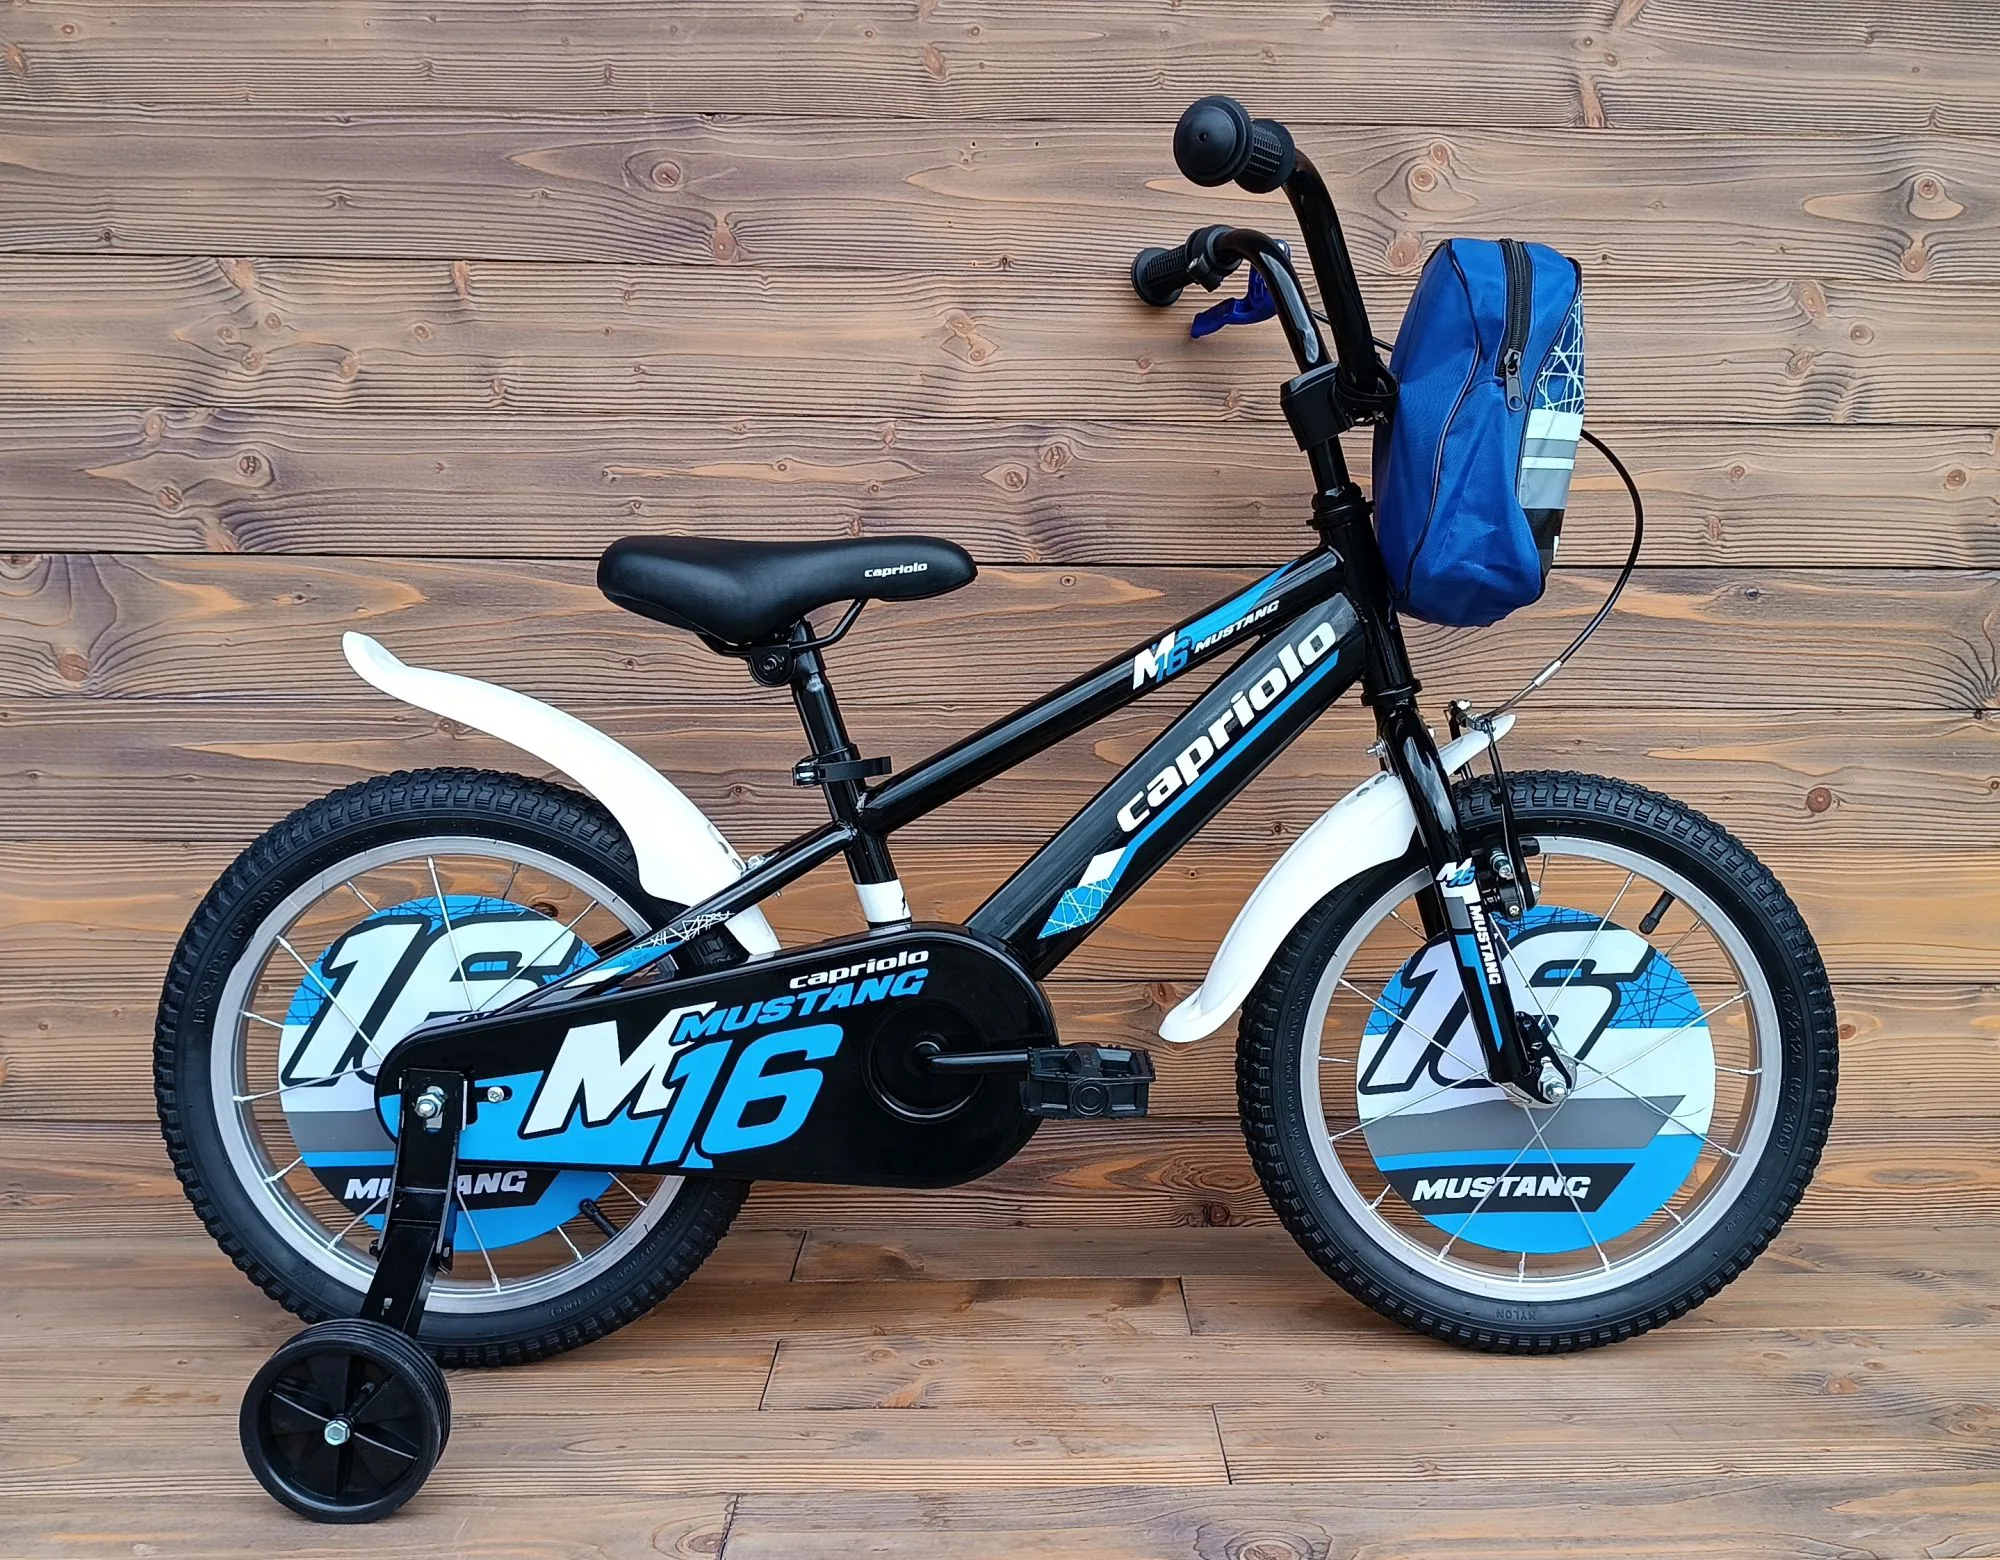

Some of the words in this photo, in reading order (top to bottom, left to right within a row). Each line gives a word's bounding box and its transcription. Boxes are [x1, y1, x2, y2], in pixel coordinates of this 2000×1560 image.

[864, 562, 929, 579] capriolo
[1193, 599, 1281, 654] MUSTANG
[1115, 620, 1338, 834] capriolo
[1468, 904, 1503, 986] MUSTANG
[788, 950, 930, 990] capriolo
[673, 967, 931, 1043] MUSTANG
[344, 1170, 528, 1201] MANG
[1411, 1176, 1592, 1202] MUSTANG
